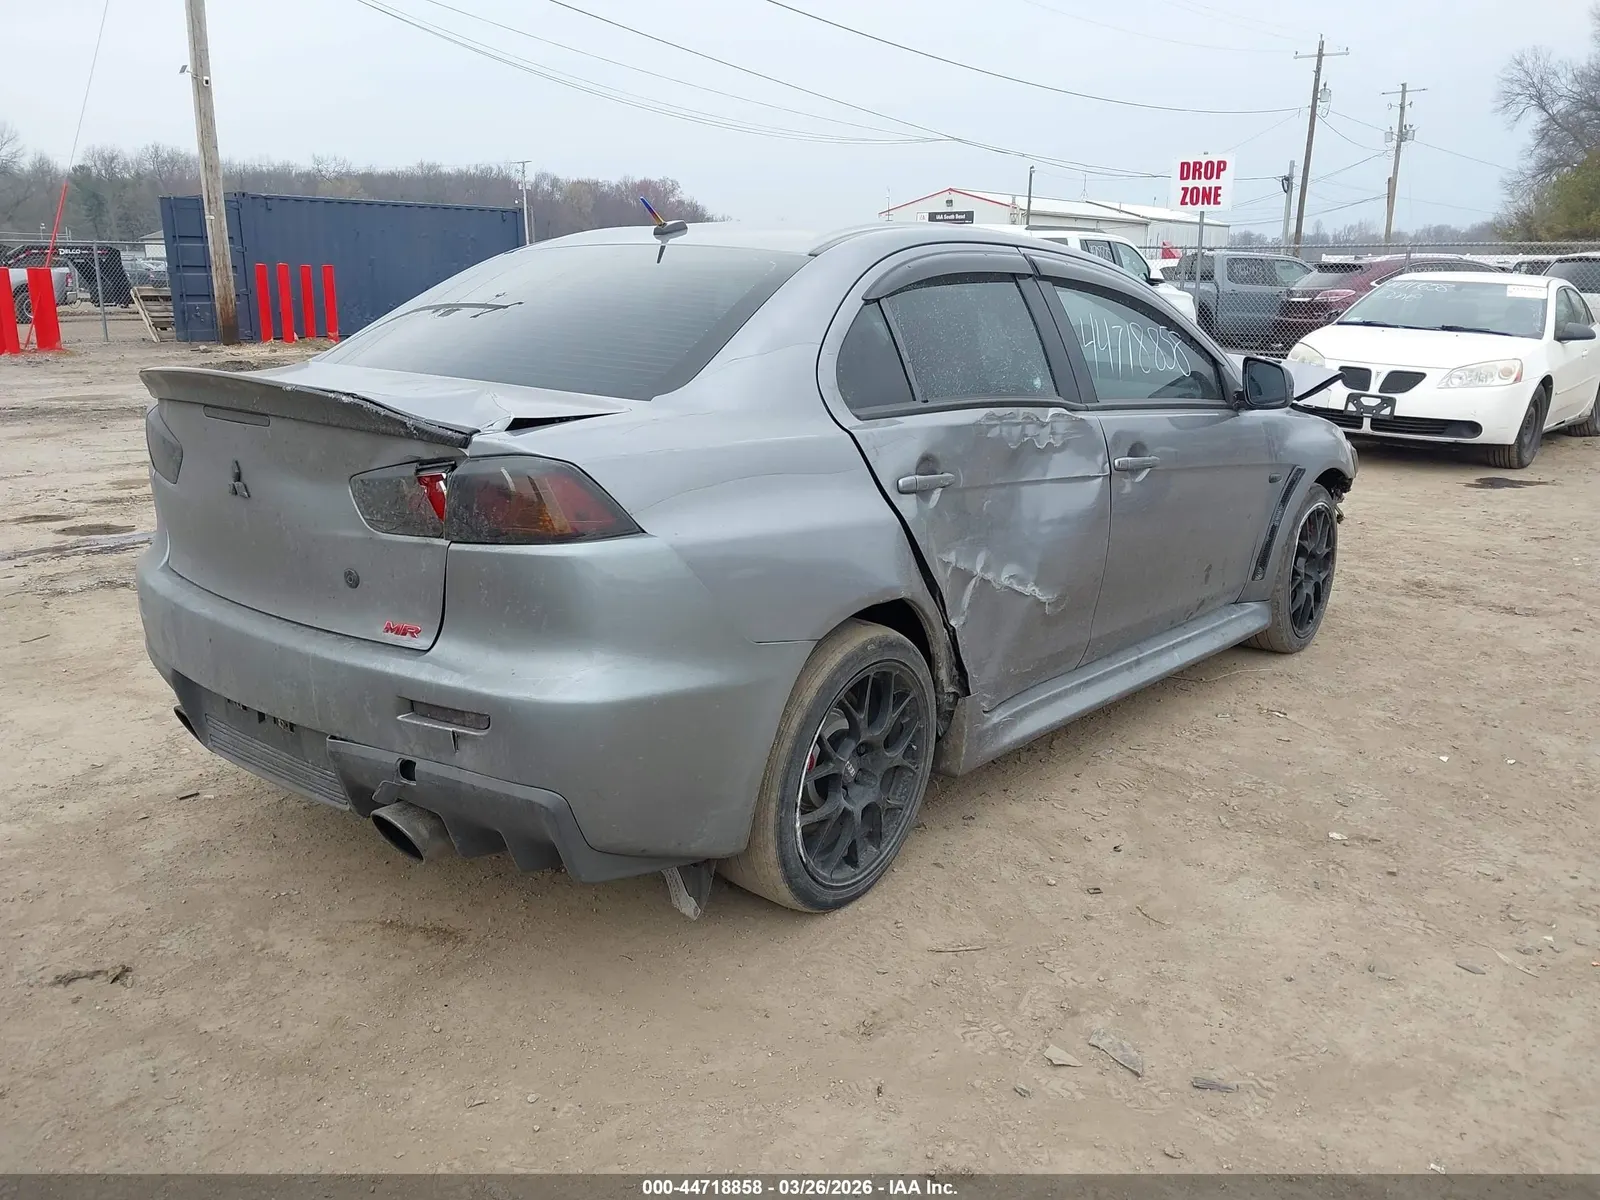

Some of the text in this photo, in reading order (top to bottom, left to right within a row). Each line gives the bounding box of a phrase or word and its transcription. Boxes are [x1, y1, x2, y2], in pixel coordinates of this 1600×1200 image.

[1180, 160, 1227, 180] DROP
[1180, 186, 1222, 206] ZONE
[1079, 312, 1192, 380] 44718858
[383, 620, 422, 639] MR
